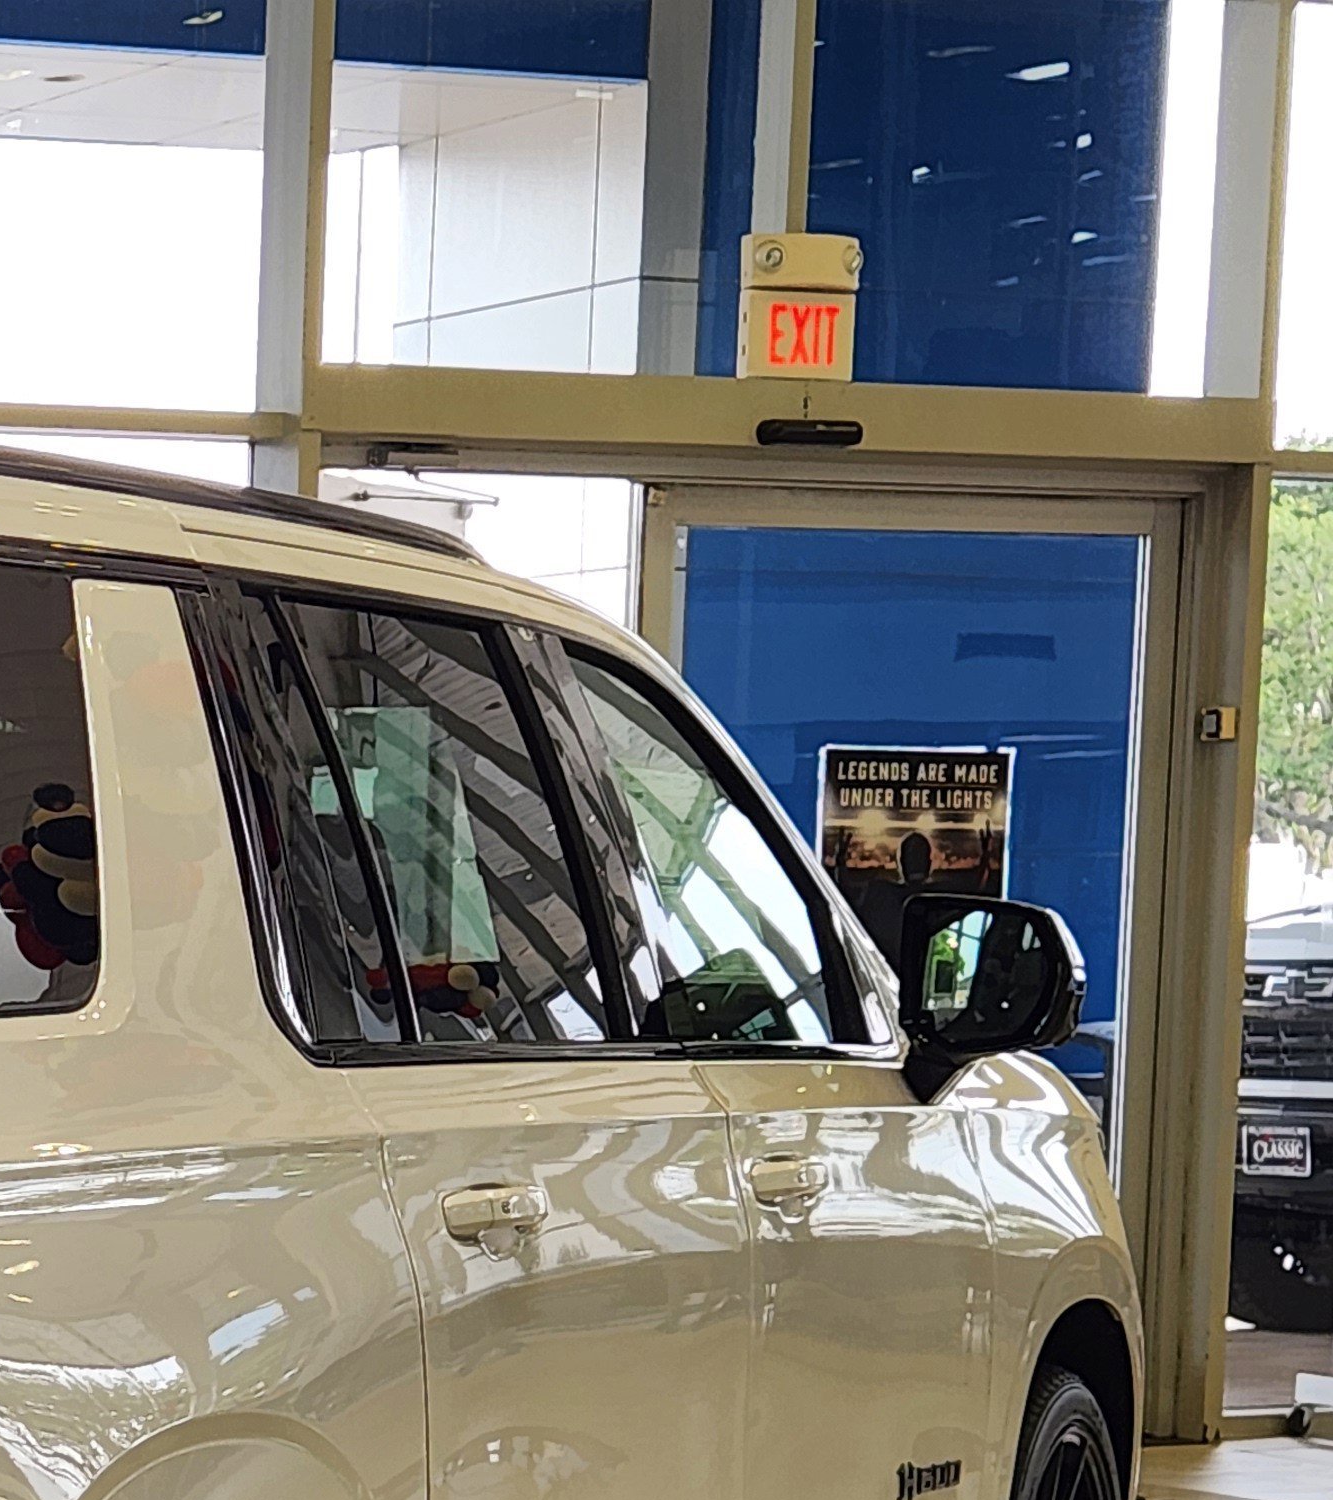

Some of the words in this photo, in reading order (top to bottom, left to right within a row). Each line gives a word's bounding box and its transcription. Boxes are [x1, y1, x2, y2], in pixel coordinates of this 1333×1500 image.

[769, 303, 840, 367] EXIT
[837, 760, 910, 781] LEGENDS
[916, 762, 948, 783] ARE
[954, 764, 999, 784] MADE
[839, 787, 895, 808] UNDER
[899, 788, 931, 809] THE
[935, 789, 994, 810] LIGHTS
